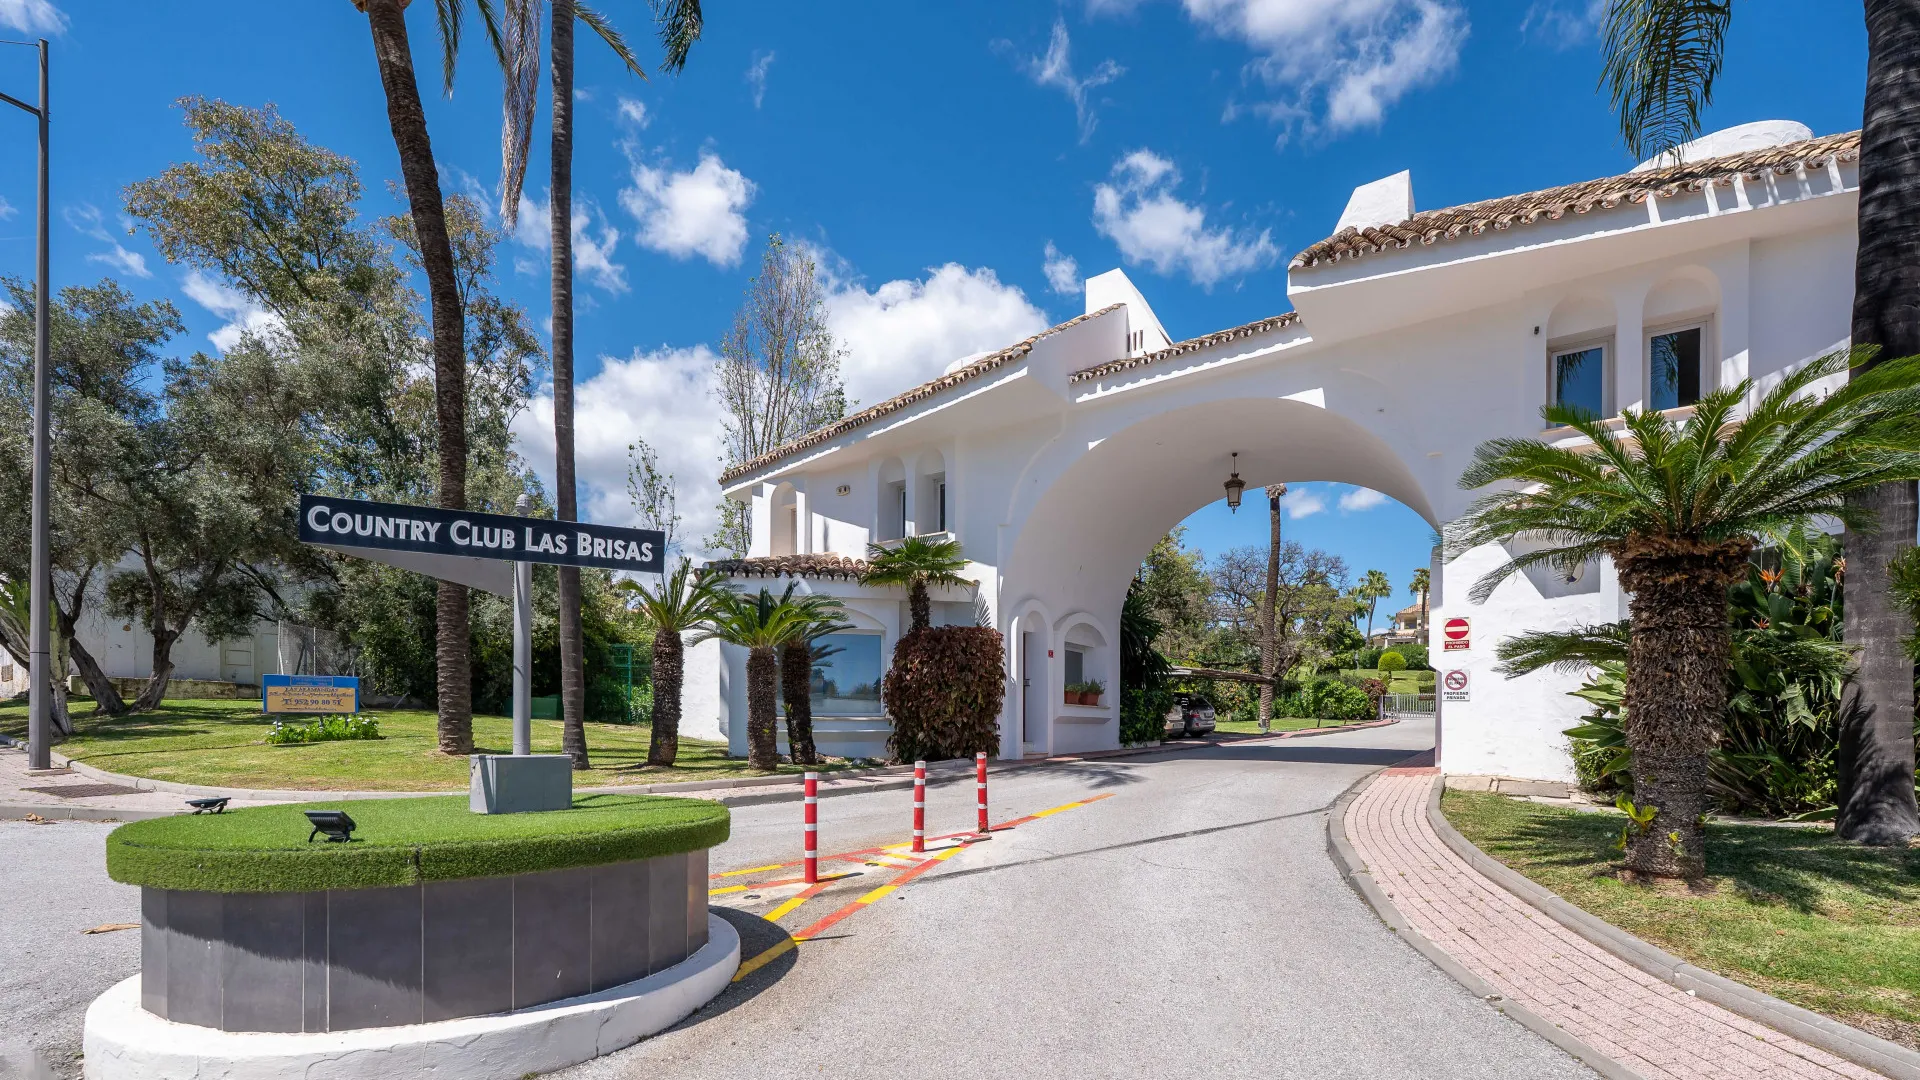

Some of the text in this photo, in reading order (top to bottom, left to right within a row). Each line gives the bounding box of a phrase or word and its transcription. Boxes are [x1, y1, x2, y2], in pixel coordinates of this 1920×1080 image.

[307, 505, 653, 562] COUNTRY CLUB LAS BRISAS
